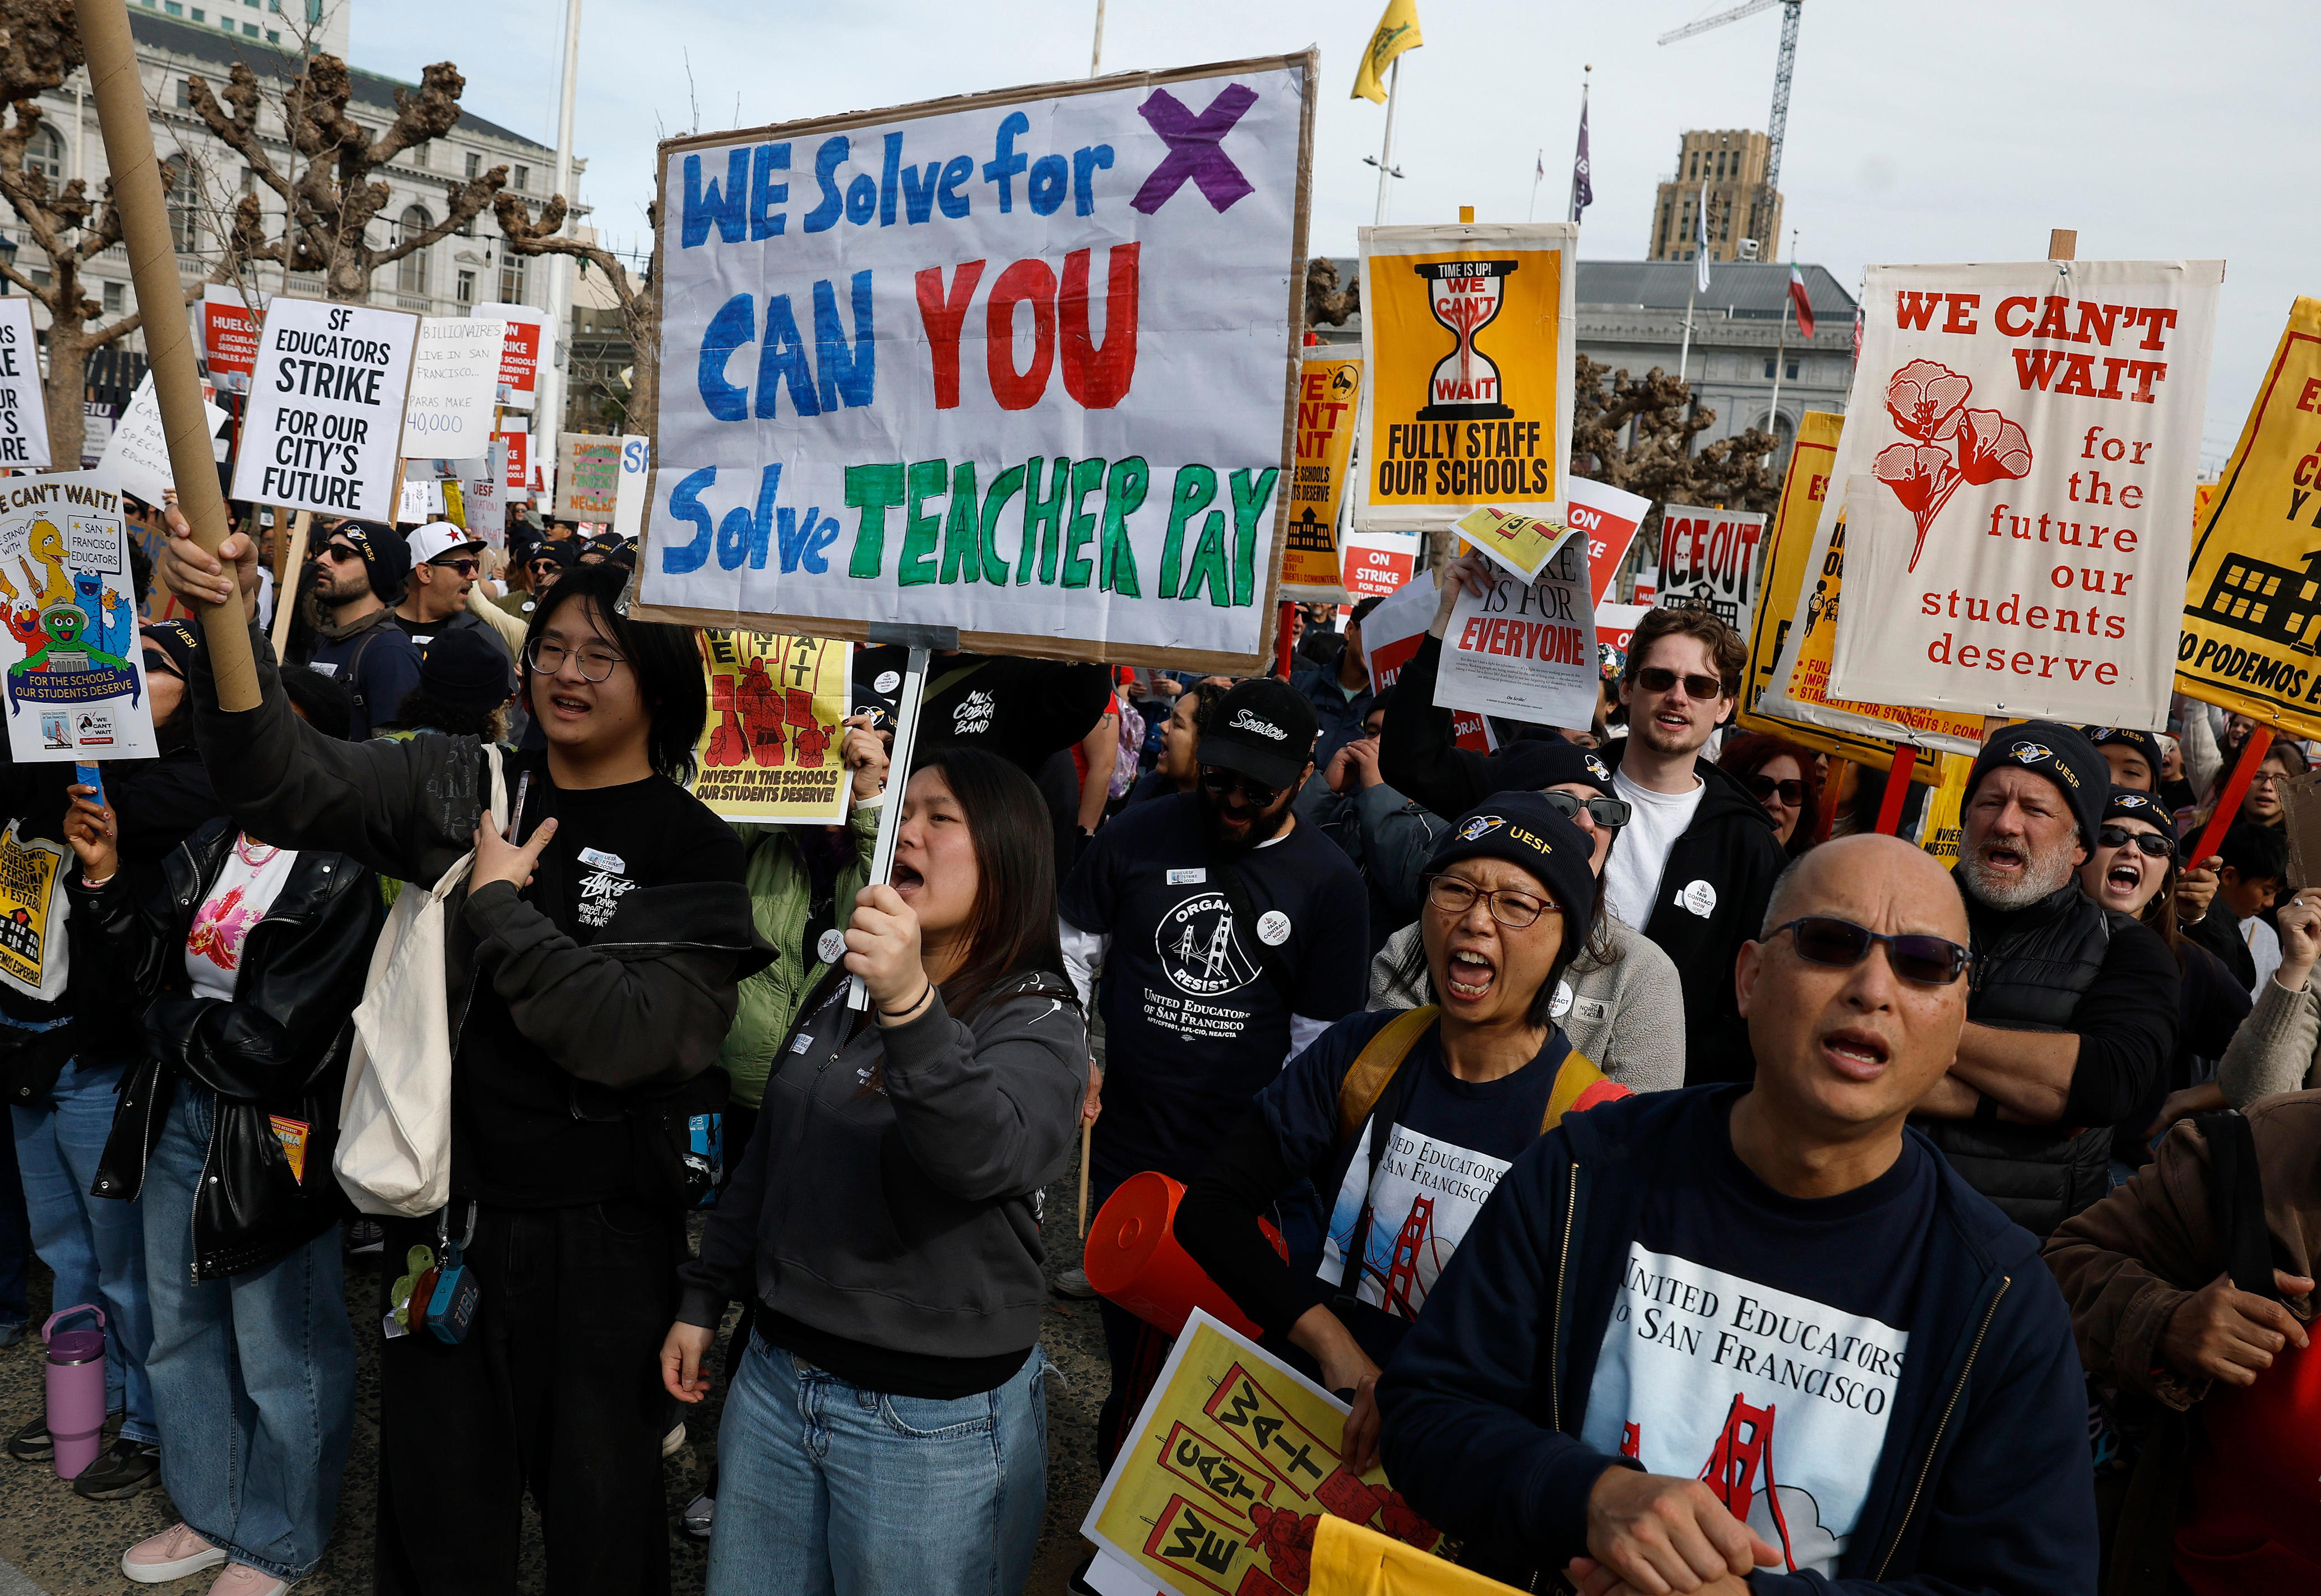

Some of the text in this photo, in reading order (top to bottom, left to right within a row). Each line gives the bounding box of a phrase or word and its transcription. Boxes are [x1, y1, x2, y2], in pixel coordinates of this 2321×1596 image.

[682, 82, 1259, 249] WE Solve for X
[1438, 263, 1492, 278] TIME IS UP!
[1445, 277, 1486, 293] WE
[1436, 296, 1495, 315] CAN'T
[328, 309, 353, 331] SF
[423, 324, 501, 339] BILLIONAIRES
[698, 241, 1141, 421] CAN YOU
[1897, 291, 2178, 351] WE CAN'T
[276, 330, 391, 365] EDUCATORS
[418, 349, 489, 360] LIVE IN SAN
[503, 341, 527, 354] RIKE
[504, 356, 536, 366] SCHOOLS
[276, 357, 385, 406] STRIKE
[498, 374, 519, 383] SERVE
[2012, 348, 2167, 404] WAIT
[409, 395, 472, 407] PARAS MAKE
[1434, 377, 1496, 401] WAIT
[275, 407, 368, 445] FOR OUR
[407, 412, 462, 435] 40,000
[1298, 402, 1348, 430] N'T
[145, 425, 163, 440] FOR
[1388, 421, 1541, 460] FULLY STAFF
[276, 436, 358, 475] CITY'S
[2081, 426, 2152, 465] for
[1301, 466, 1330, 483] SCHOOLS
[1379, 458, 1548, 497] OUR SCHOOLS
[11, 483, 118, 513] CAN'T WAIT!
[262, 467, 364, 511] FUTURE
[473, 483, 493, 497] UESF
[1302, 485, 1330, 503] DESERVE
[2068, 471, 2144, 509] the
[2287, 488, 2311, 521] Y
[85, 523, 103, 535] SAN
[662, 456, 1280, 607] Solve TEACHER PAY
[1571, 509, 1601, 530] ON
[1988, 504, 2139, 553] future
[3, 526, 25, 543] STAND
[2, 541, 21, 556] WITH
[362, 542, 375, 562] UESF
[1369, 553, 1389, 565] ON
[1657, 517, 1762, 605] ICE OUT
[1356, 568, 1398, 584] STRIKE
[2051, 564, 2134, 596] our
[1375, 584, 1393, 593] SPED
[1480, 580, 1576, 622] IS FOR
[1922, 588, 2126, 639] students
[1458, 617, 1585, 666] EVERYONE
[1928, 632, 2119, 686] deserve
[2194, 639, 2308, 698] PODEMOS
[15, 679, 133, 699] OUR STUDENTS DESERVE
[29, 670, 115, 686] FOR THE SCHOOLS
[966, 689, 993, 704] MLK
[953, 702, 995, 720] COBRA
[1857, 702, 1948, 732] FOR STUDENTS &
[955, 720, 989, 735] BAND
[1229, 709, 1287, 740] Sonics
[2121, 730, 2144, 743] UESF
[701, 770, 838, 785] INVEST IN THE SCHOOLS
[2055, 759, 2080, 790] UESF
[697, 785, 835, 802] OUR STUDENTS DESERVE!
[1509, 825, 1553, 856] UESF
[1688, 893, 1713, 906] CONTRACT
[1263, 920, 1287, 939] CONTRACT
[1267, 921, 1278, 930] FAIR
[1272, 929, 1284, 939] NOW
[824, 935, 840, 959] CONTRACT
[831, 944, 839, 955] NOW
[13, 959, 39, 984] ESPERAR
[1173, 968, 1229, 992] RESIST
[1144, 987, 1180, 1009] UNITED
[1580, 1005, 1597, 1013] NORTH
[1156, 1006, 1178, 1022] SAN
[1180, 1012, 1244, 1031] FRANCISCO
[1181, 1026, 1208, 1036] AFL-CIO,
[1418, 1142, 1504, 1185] EDUCATORS
[1410, 1162, 1490, 1205] FRANCISCO
[455, 1287, 479, 1327] JBL
[1731, 1295, 1906, 1379] EDUCATORS
[1638, 1307, 1884, 1415] SAN FRANCISCO
[1220, 1380, 1322, 1479] WAIT
[1177, 1439, 1255, 1502] CAN'T
[1163, 1507, 1239, 1574] WE
